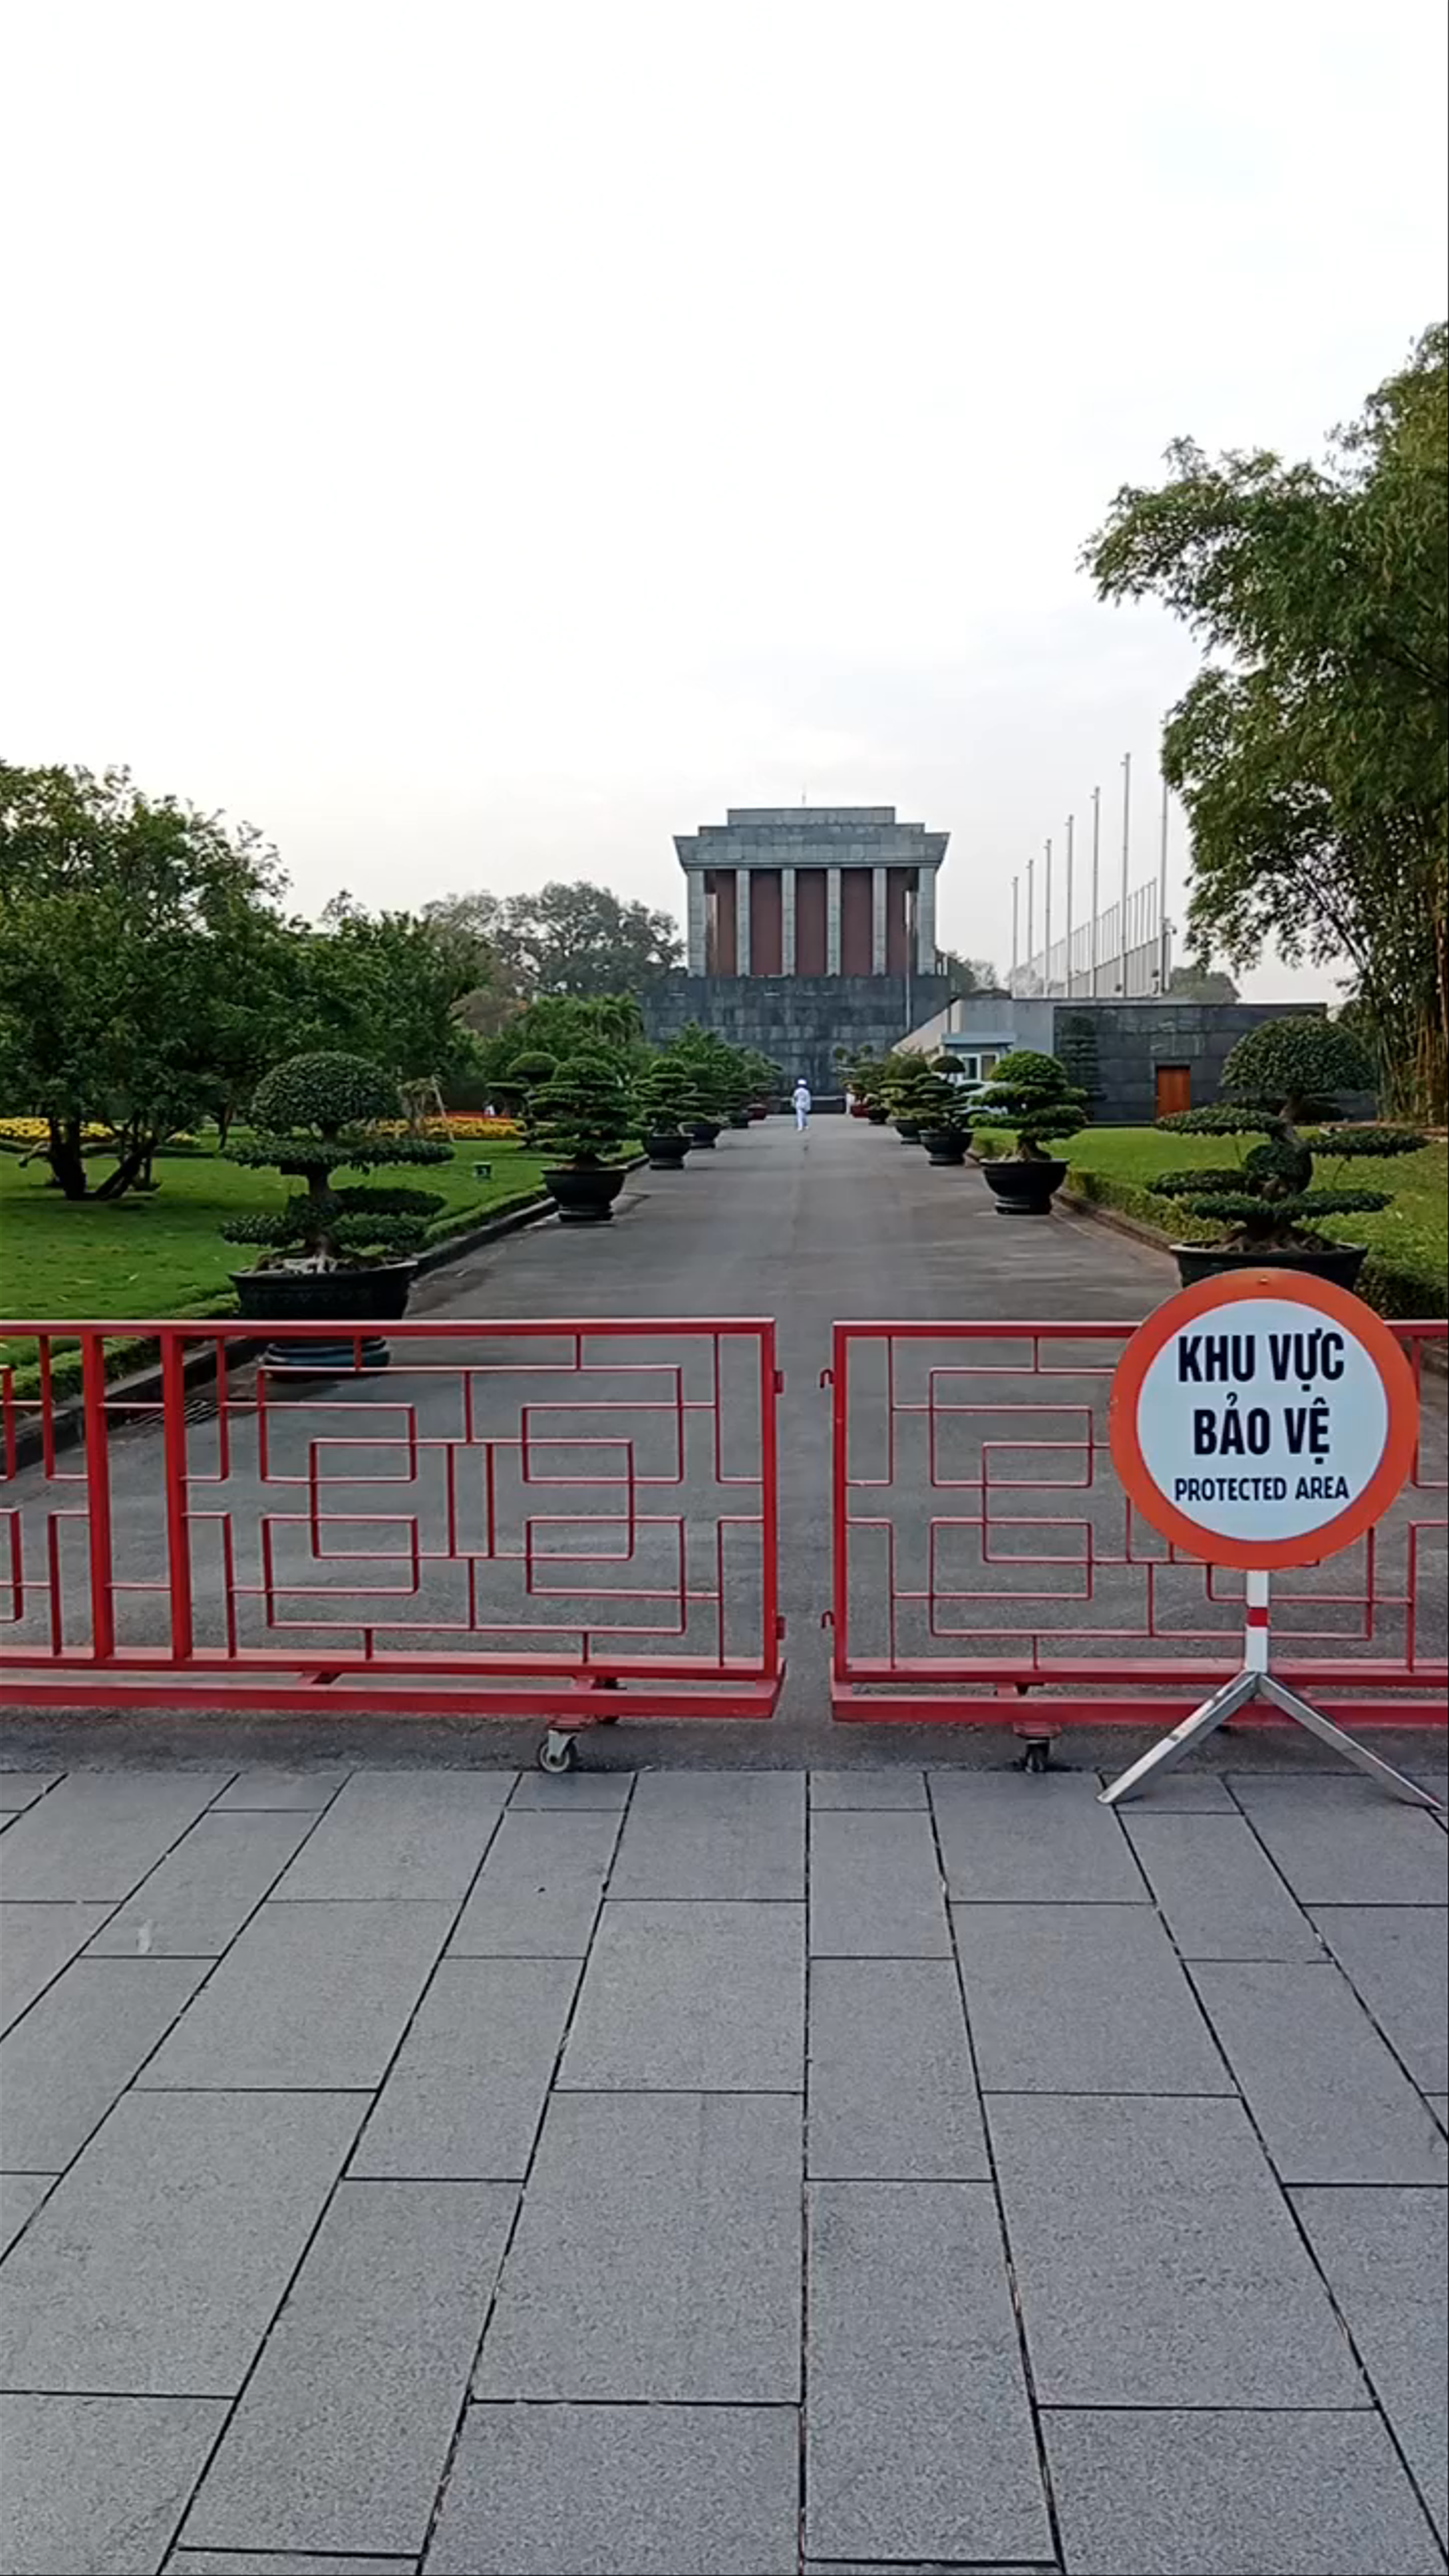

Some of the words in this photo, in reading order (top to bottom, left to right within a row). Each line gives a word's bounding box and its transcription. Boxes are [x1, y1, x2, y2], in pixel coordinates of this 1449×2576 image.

[1178, 1335, 1255, 1382] KHU
[1269, 1328, 1344, 1392] VỰC
[1194, 1392, 1270, 1455] BẢO
[1284, 1397, 1330, 1464] VỆ
[1175, 1478, 1287, 1501] PROTECTED
[1295, 1476, 1349, 1499] AREA
